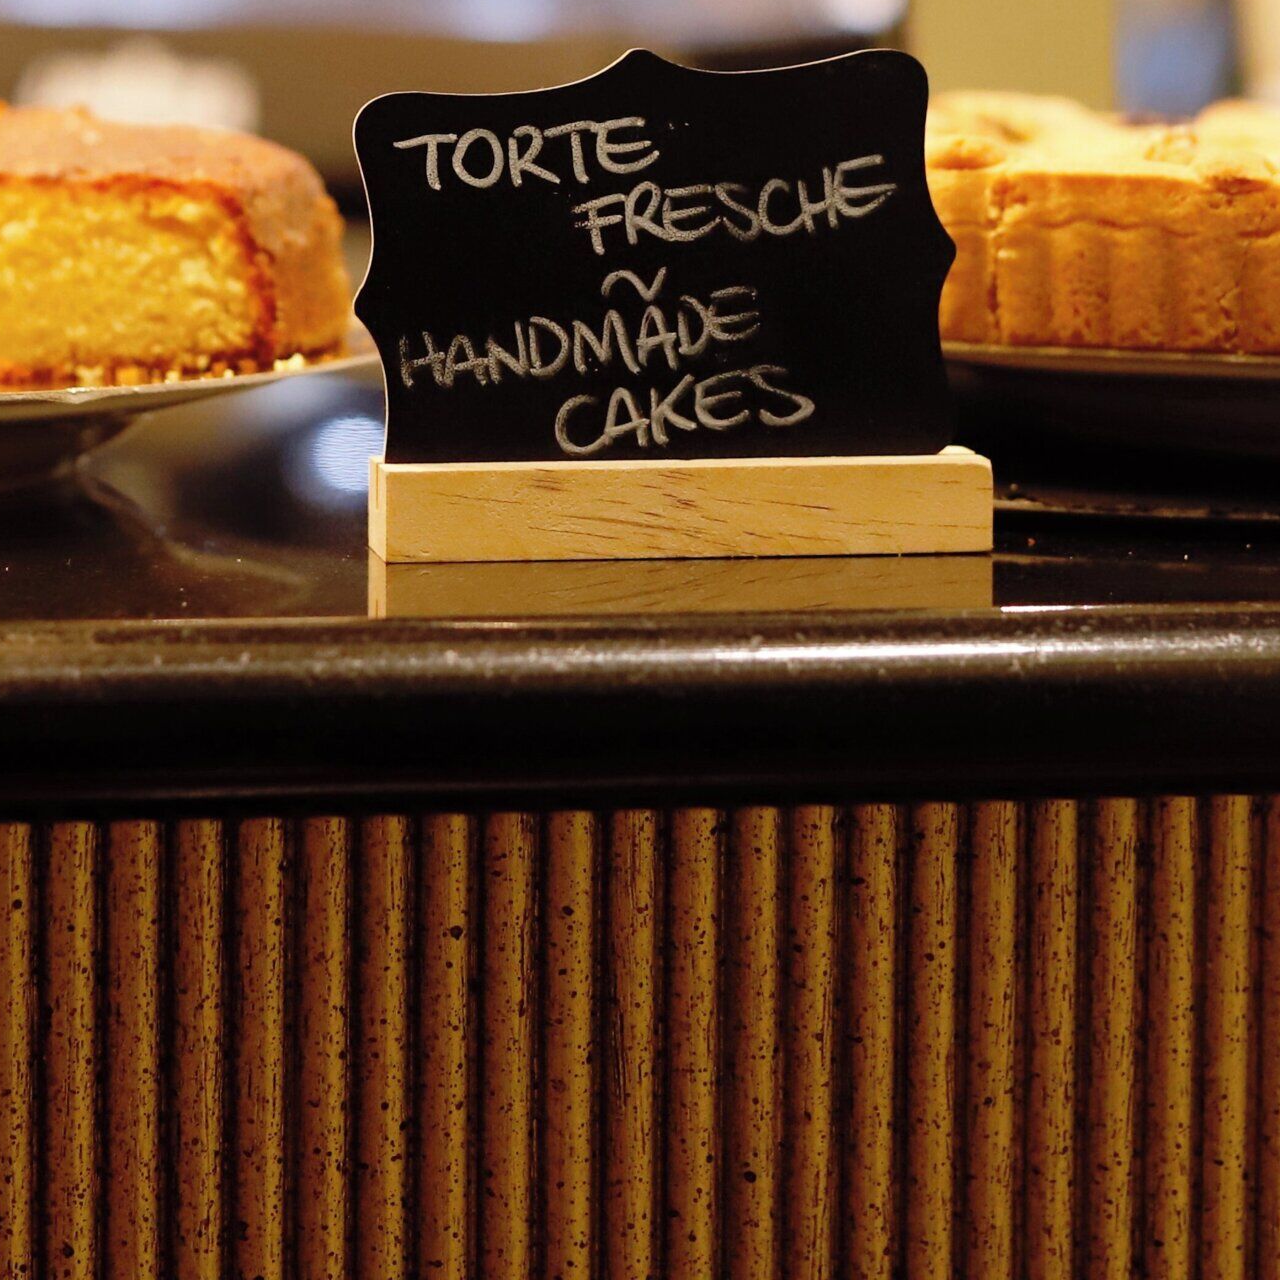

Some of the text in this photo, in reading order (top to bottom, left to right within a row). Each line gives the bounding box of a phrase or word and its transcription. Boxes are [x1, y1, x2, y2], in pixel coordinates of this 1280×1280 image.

[393, 116, 660, 192] TORTE
[574, 154, 897, 255] FRESCHE
[399, 285, 760, 388] HANDMADE
[554, 364, 816, 456] CAKES
